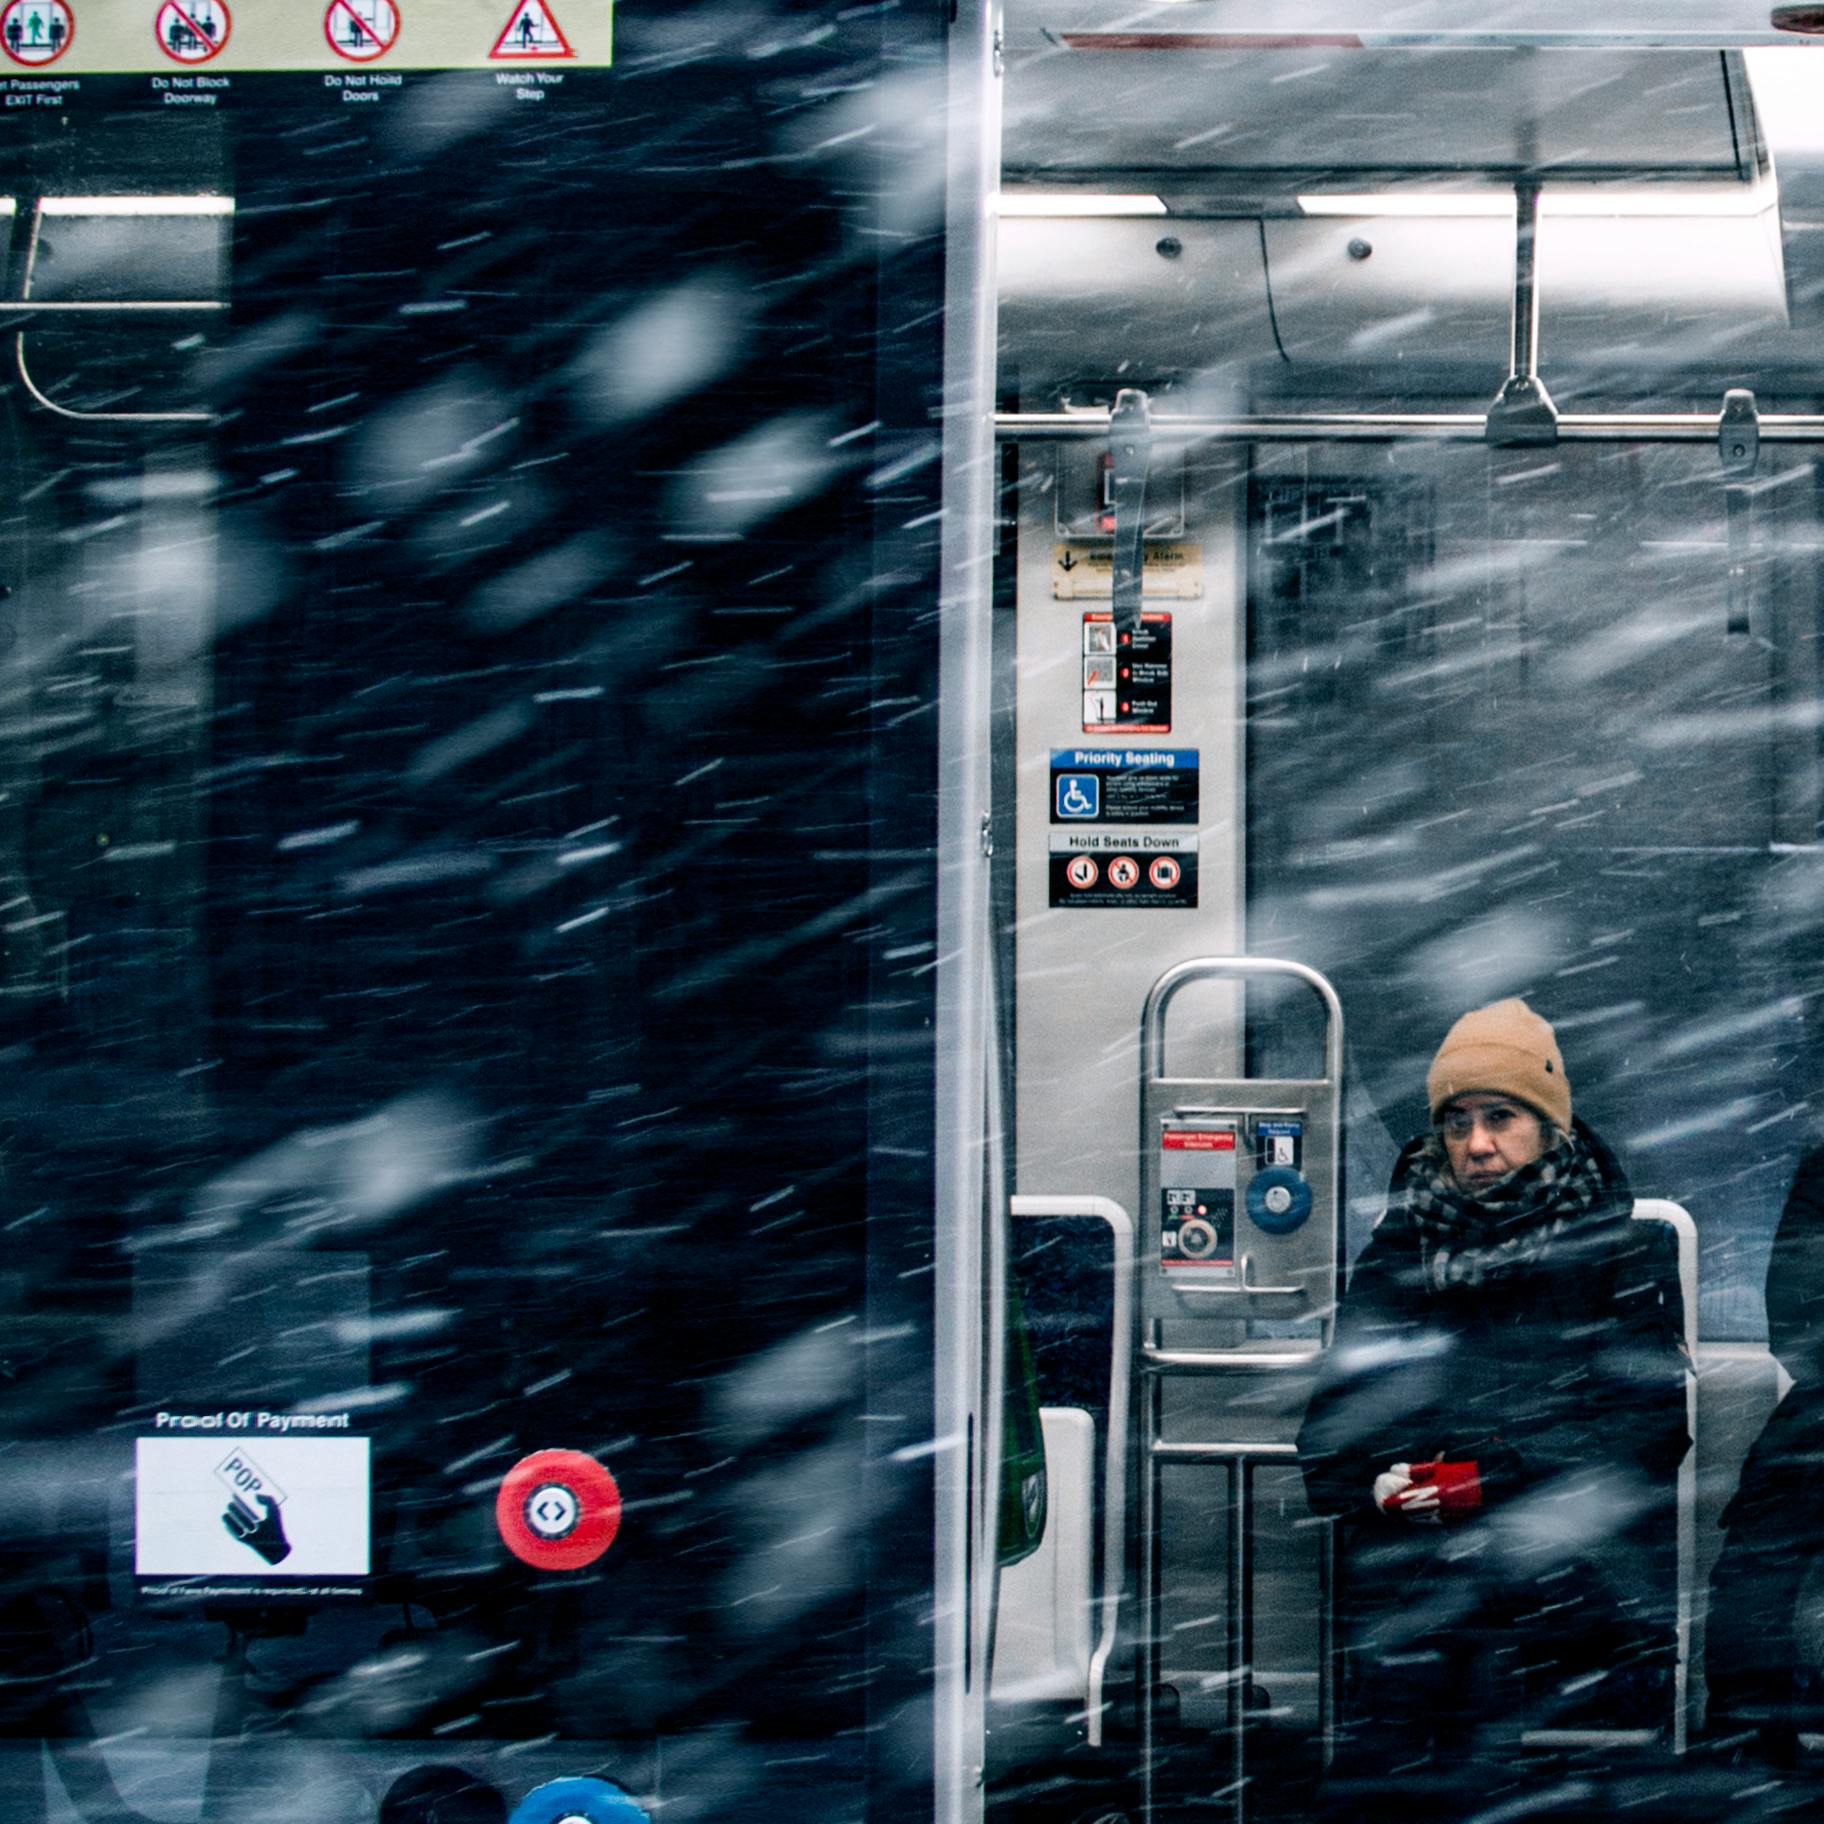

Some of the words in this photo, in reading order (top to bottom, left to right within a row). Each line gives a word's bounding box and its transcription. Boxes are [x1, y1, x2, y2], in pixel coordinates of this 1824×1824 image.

[151, 77, 169, 88] Do
[172, 77, 195, 88] Not
[196, 76, 232, 88] Block
[324, 75, 342, 87] Do
[345, 75, 367, 87] Not
[369, 74, 402, 87] Hold
[495, 72, 535, 85] Watch
[536, 72, 564, 85] Your
[10, 79, 80, 93] Passengers
[5, 94, 32, 106] EXIT
[36, 93, 63, 106] First
[164, 92, 217, 106] Doorway
[342, 90, 379, 102] Doors
[516, 88, 545, 101] Step
[1152, 551, 1183, 560] Alarm
[1075, 751, 1122, 767] Priority
[1125, 751, 1175, 768] Seating
[1069, 836, 1099, 847] Hold
[1103, 836, 1139, 847] Seats
[1143, 837, 1180, 847] Down
[155, 1412, 223, 1428] Proof
[226, 1412, 250, 1428] Of
[257, 1412, 349, 1432] Payment
[224, 1457, 263, 1492] POP
